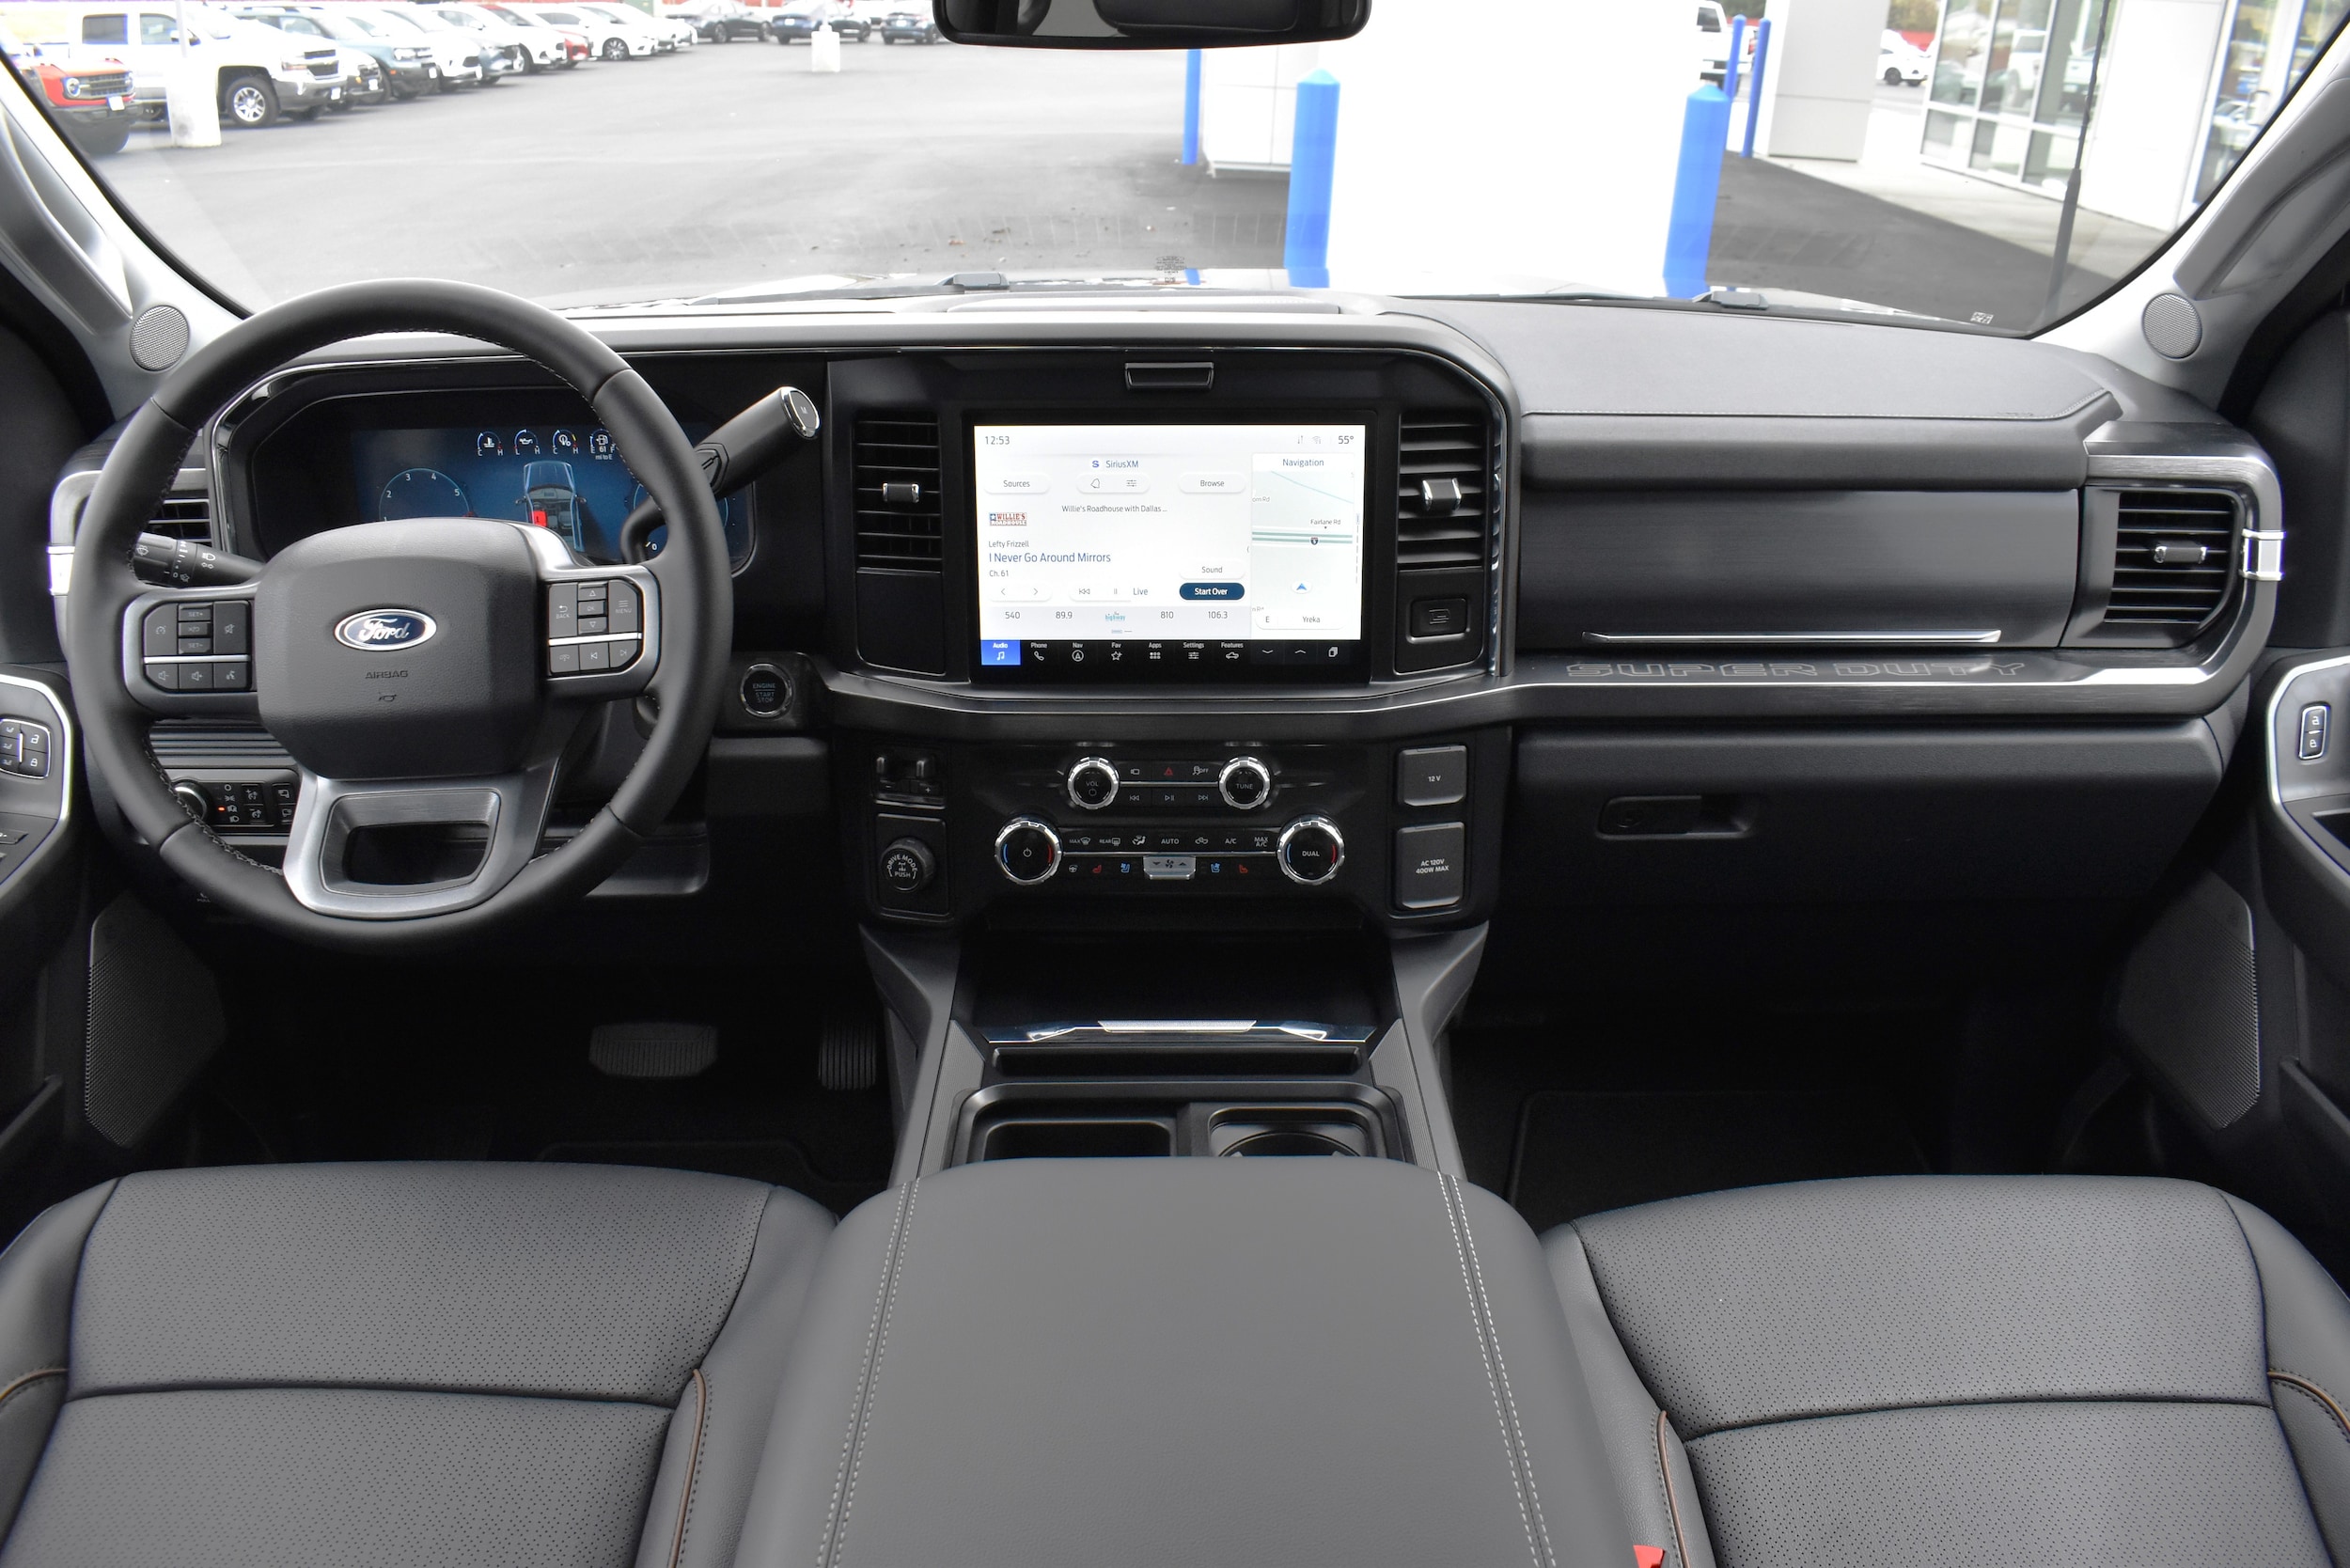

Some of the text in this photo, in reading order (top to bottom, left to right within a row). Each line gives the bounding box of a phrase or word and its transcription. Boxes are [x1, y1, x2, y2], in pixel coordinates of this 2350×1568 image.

[984, 435, 1010, 446] 12:53
[1338, 435, 1355, 445] 55°
[1105, 460, 1139, 468] SiriusXM
[1282, 458, 1324, 468] Navigation
[405, 473, 411, 481] 3
[1003, 479, 1030, 488] Sources
[1199, 479, 1225, 488] Browse
[386, 490, 392, 498] 2
[1061, 505, 1086, 513] Willie's
[1087, 505, 1123, 513] Roadhouse
[1124, 505, 1139, 513] with
[988, 541, 1005, 549] Lefty
[995, 553, 1022, 562] Never
[1024, 553, 1038, 563] Go
[1040, 553, 1075, 562] Around
[1077, 553, 1111, 562] Mirrors
[1133, 588, 1149, 596] Live
[1194, 588, 1229, 596] Start Over
[1005, 611, 1021, 619] 540
[1055, 611, 1073, 619] 89.9
[1160, 611, 1174, 619] 810
[1208, 611, 1229, 619] 106.3
[358, 618, 411, 642] Ford
[365, 669, 409, 679] AIRBAG
[1566, 662, 2025, 678] SUPER DUTY
[1160, 837, 1180, 845] AUTO
[886, 854, 918, 871] DRIVE MODE
